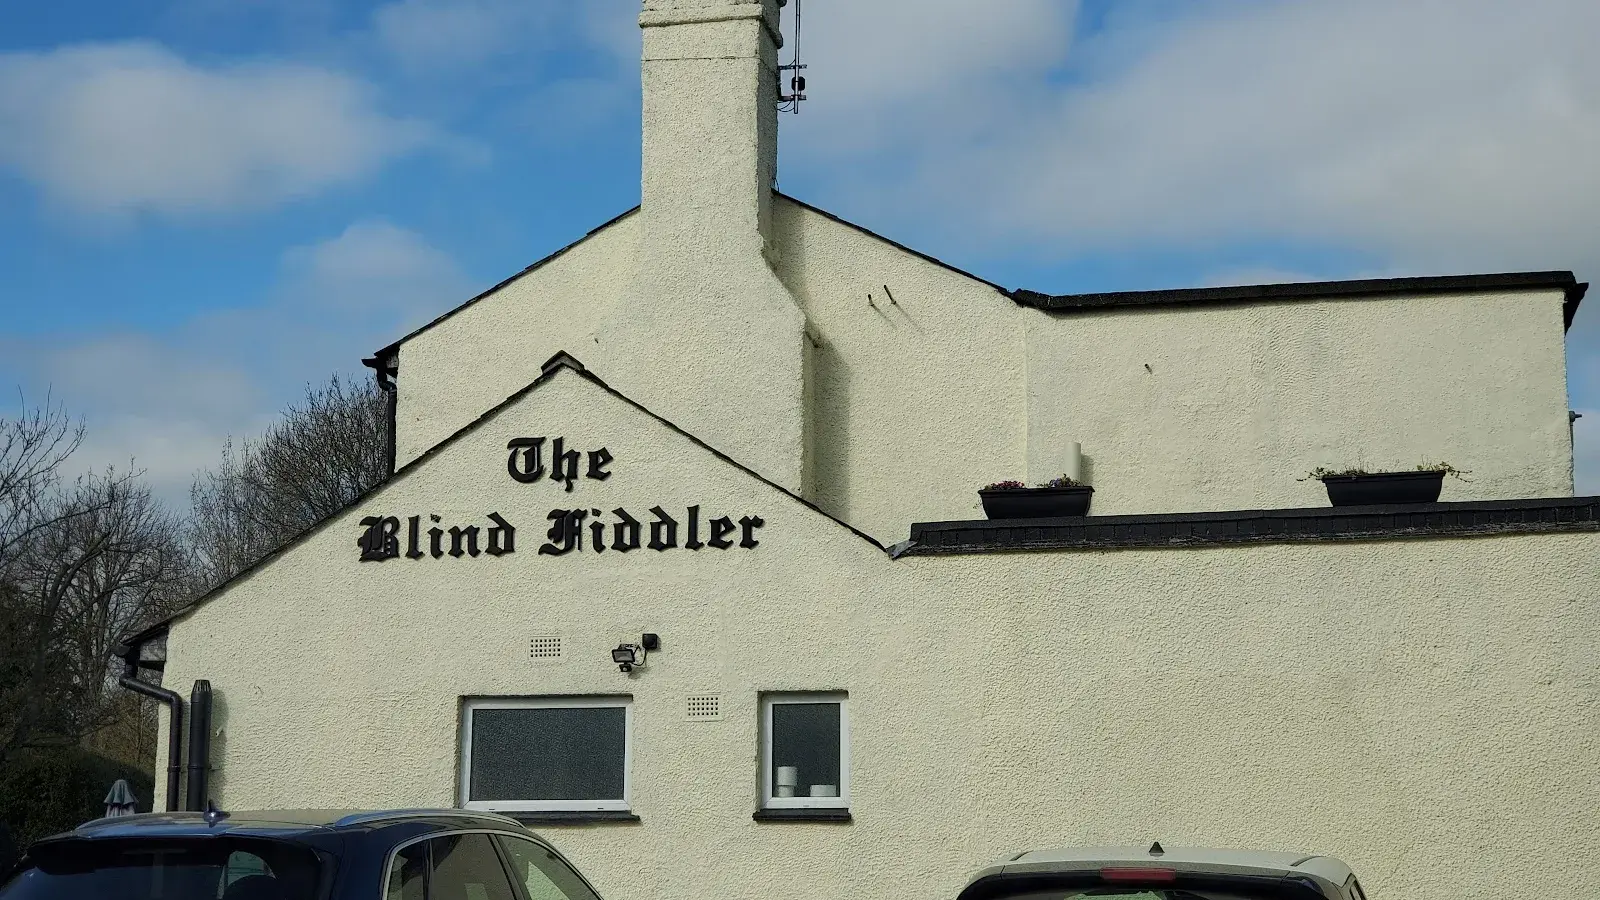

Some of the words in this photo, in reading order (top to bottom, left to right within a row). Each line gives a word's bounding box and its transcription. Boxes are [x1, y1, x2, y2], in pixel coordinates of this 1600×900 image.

[506, 435, 614, 492] The
[357, 511, 516, 562] Blind
[537, 504, 765, 556] Fiddler
